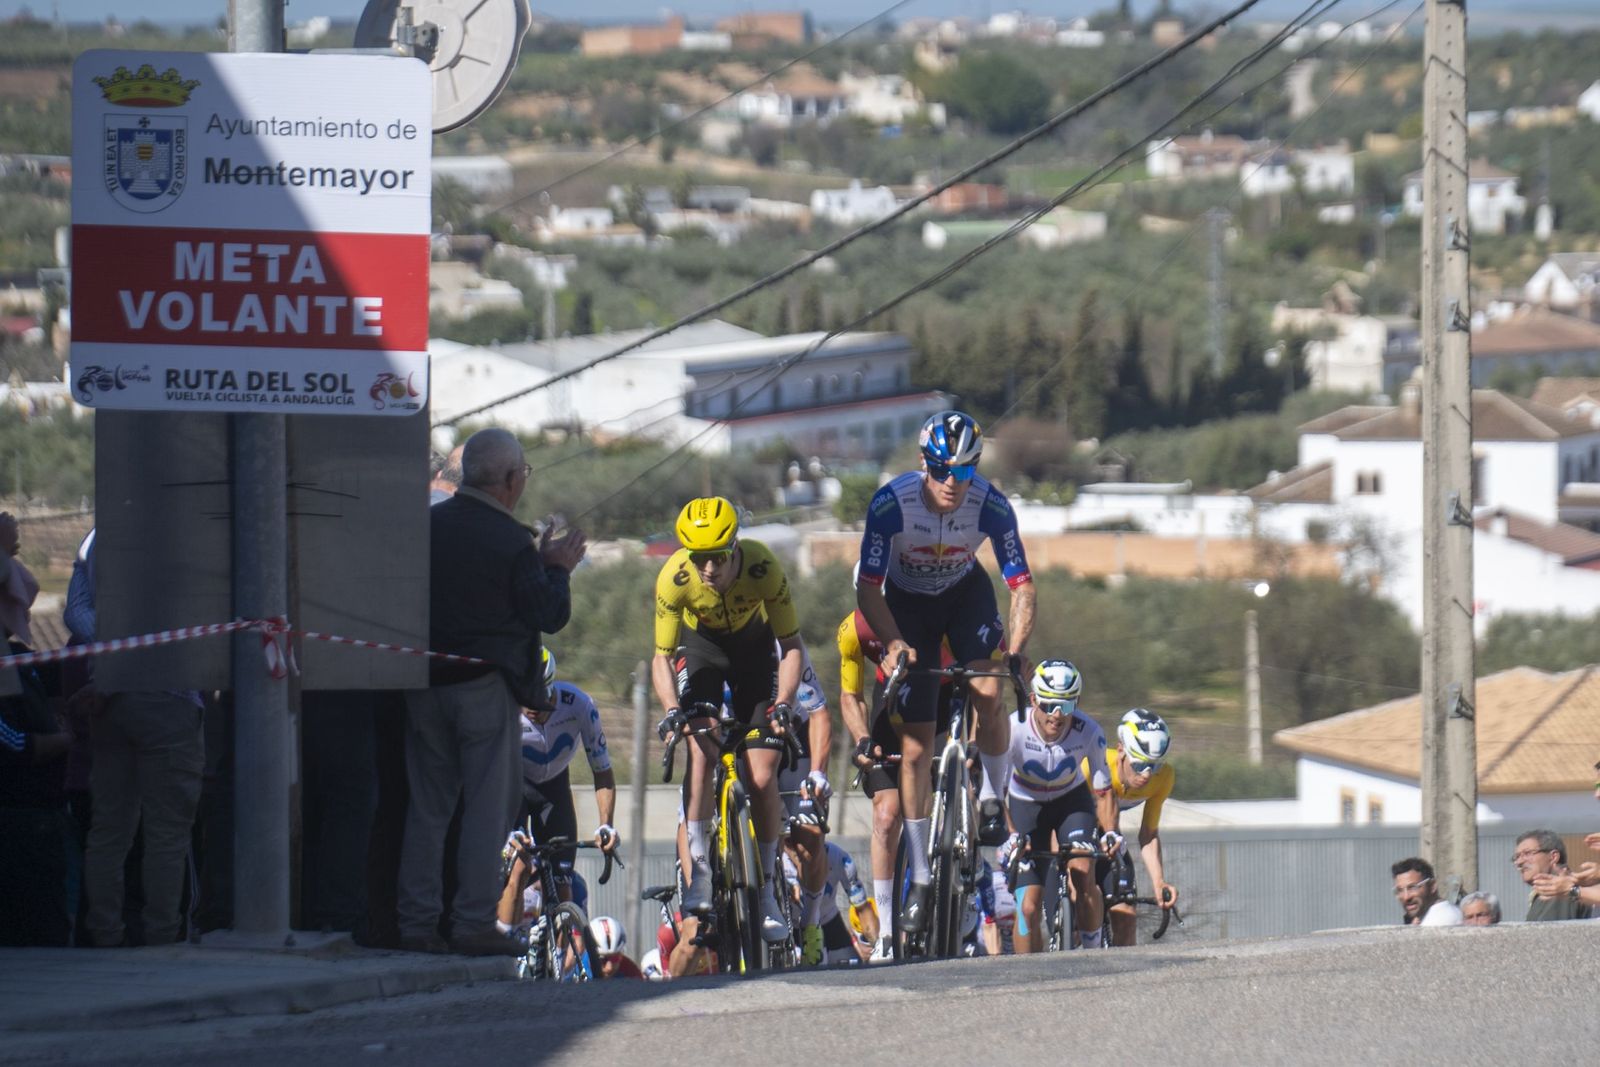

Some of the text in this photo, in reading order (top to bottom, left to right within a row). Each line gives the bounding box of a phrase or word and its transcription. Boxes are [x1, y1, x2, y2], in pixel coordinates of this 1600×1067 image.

[205, 112, 417, 140] Ayuntamiento de
[106, 128, 120, 192] TU IN EA ET
[167, 128, 185, 197] EGO PRO EA
[204, 157, 415, 195] Montemayor
[174, 241, 327, 284] META
[118, 289, 384, 336] VOLANTE
[165, 368, 239, 391] RUTA
[247, 370, 295, 393] DEL
[304, 372, 355, 395] SOL
[166, 391, 355, 406] VUELTA CICLISTA A ANDALUCÍA
[871, 491, 894, 512] BORA
[988, 492, 1010, 511] BORA
[913, 523, 931, 534] BOSS
[868, 531, 884, 567] BOSS
[1003, 530, 1023, 567] BOSS
